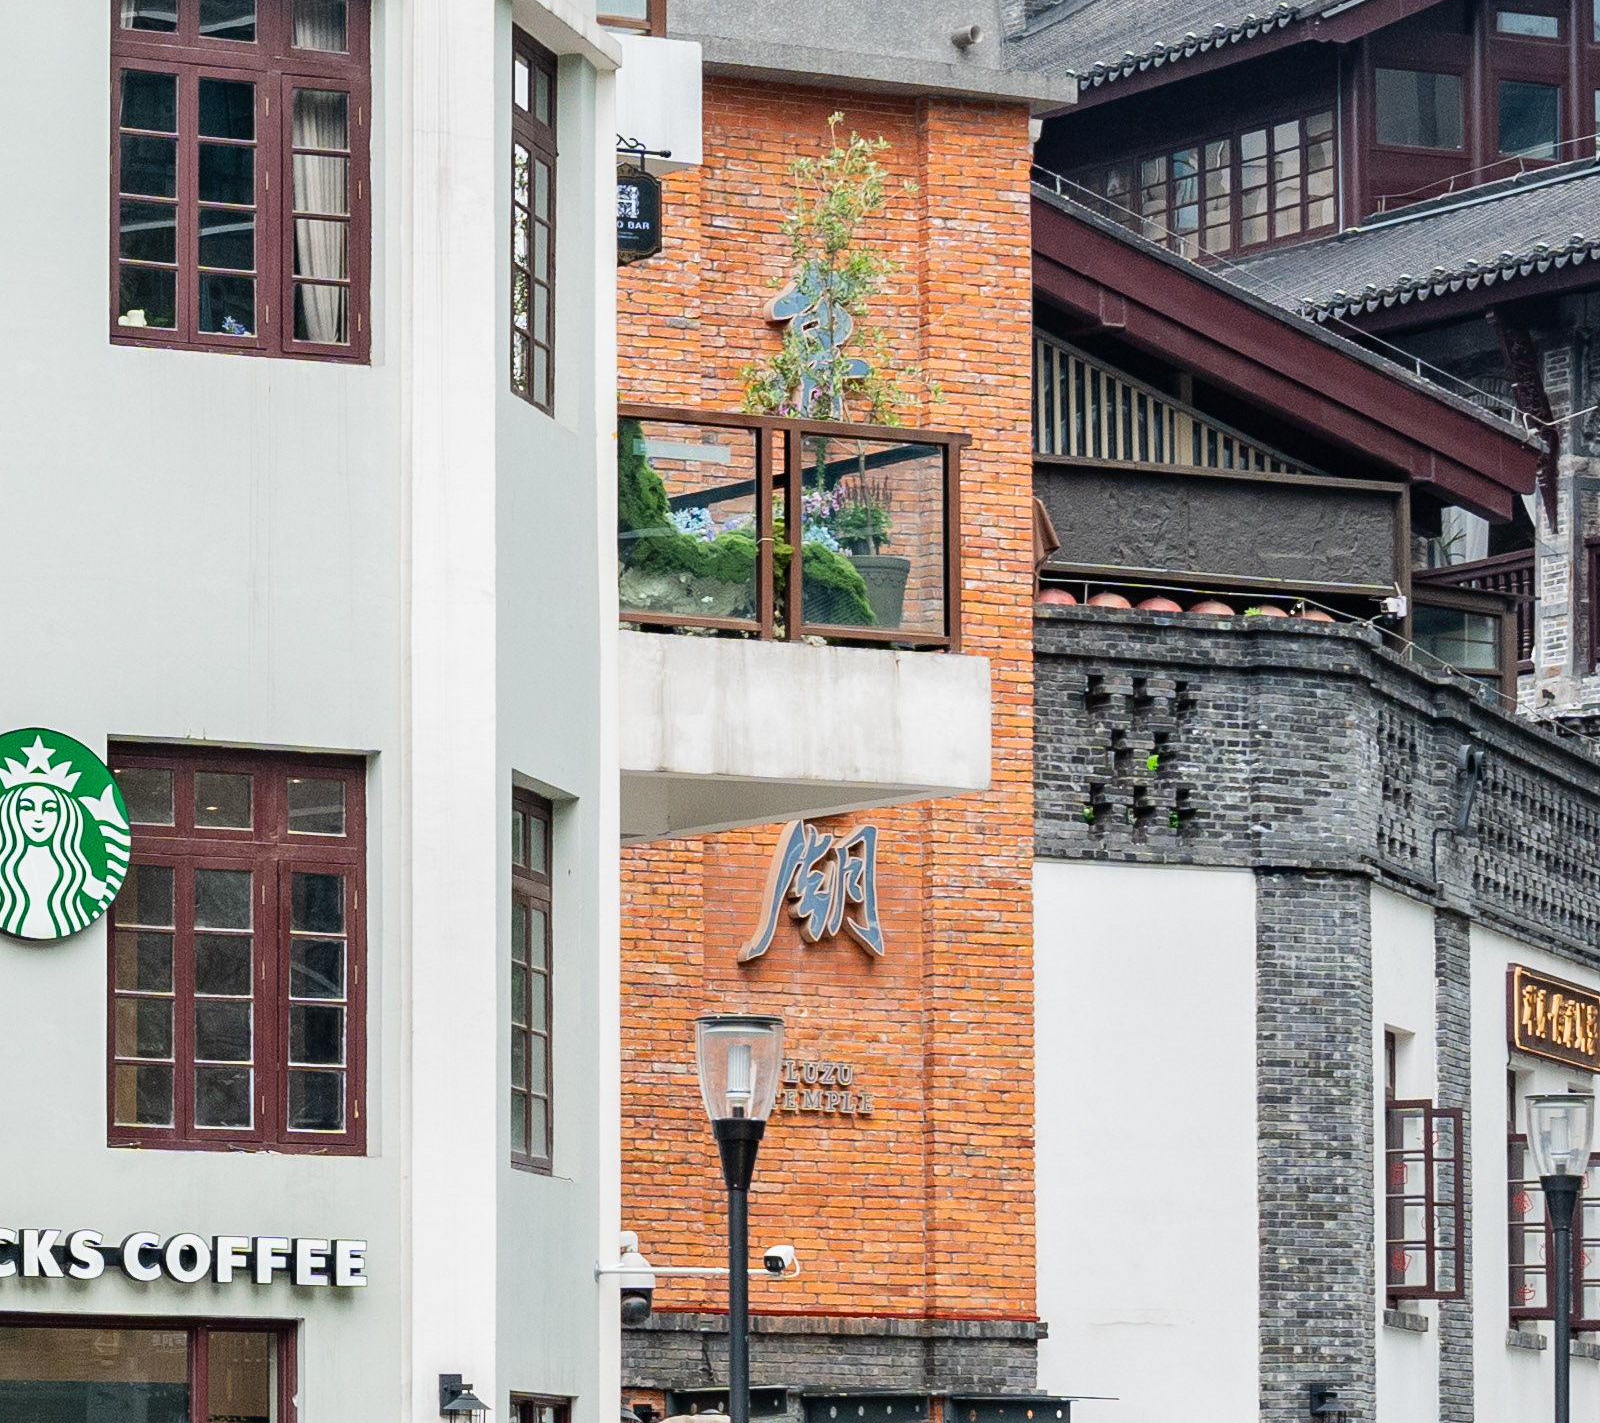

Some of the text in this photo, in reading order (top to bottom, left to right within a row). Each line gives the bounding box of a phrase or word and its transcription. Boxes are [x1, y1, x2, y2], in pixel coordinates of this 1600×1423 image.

[627, 221, 650, 230] BAR
[784, 1059, 855, 1086] LUZU
[120, 1231, 368, 1288] COFFEE
